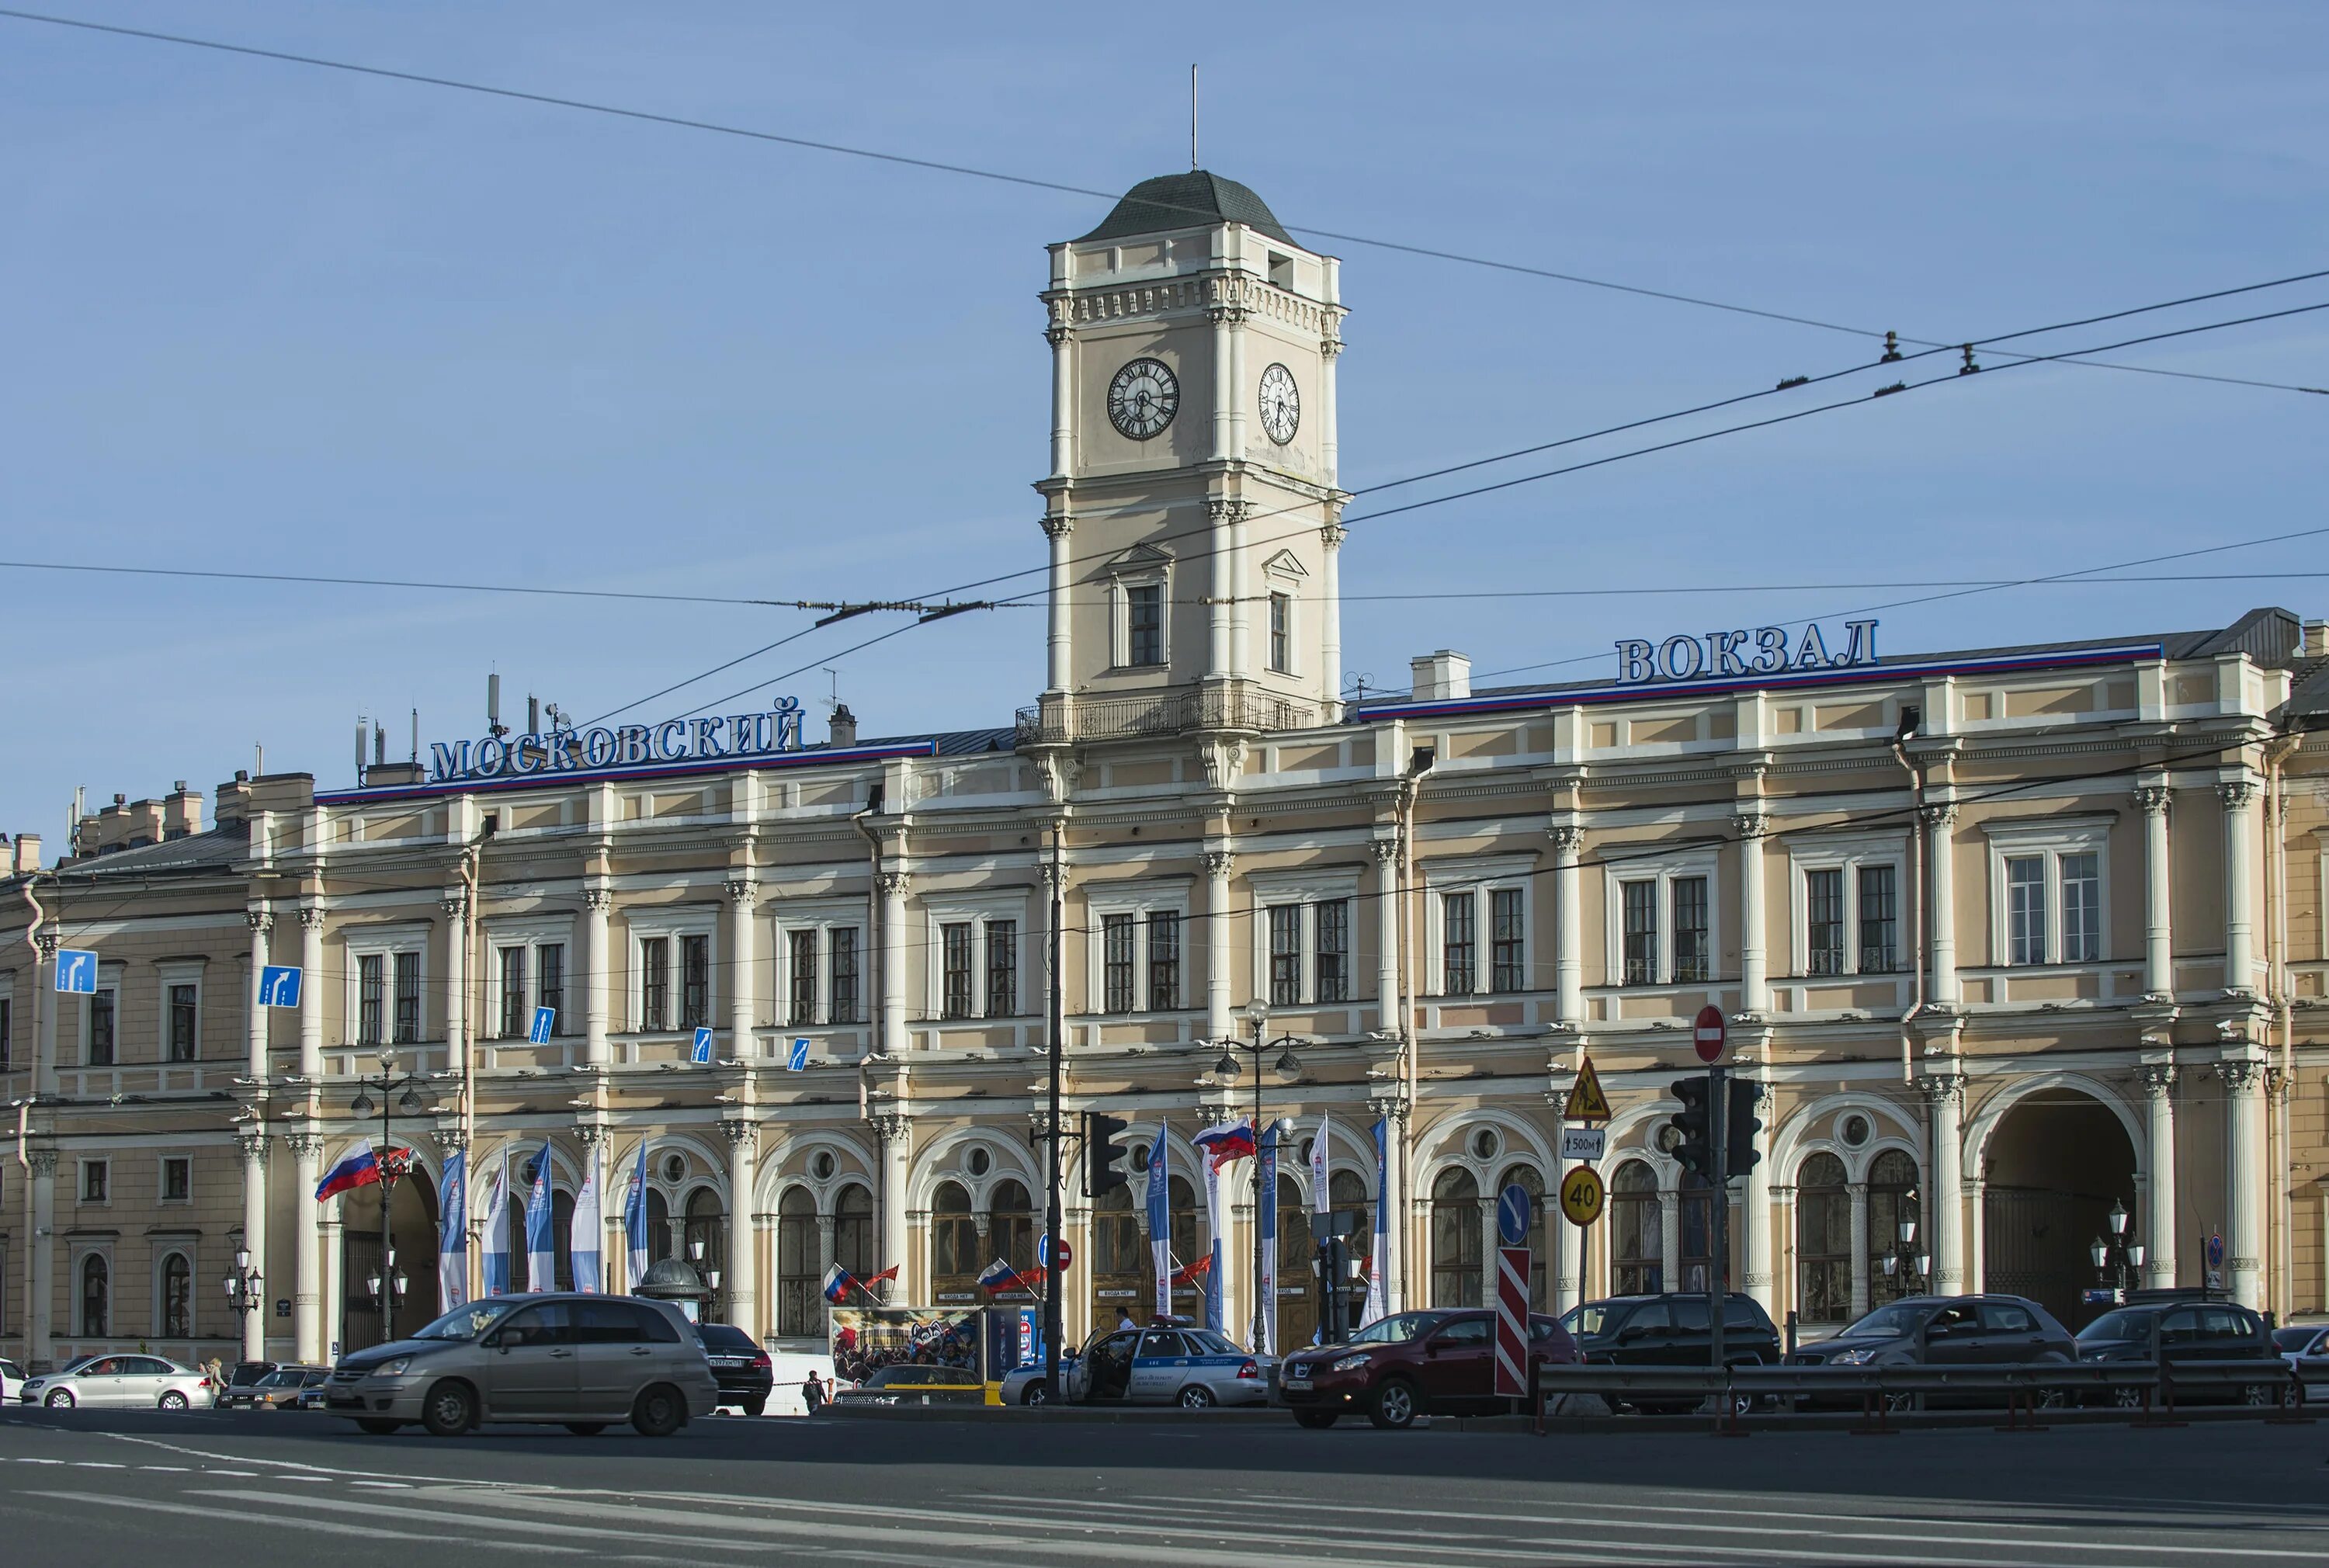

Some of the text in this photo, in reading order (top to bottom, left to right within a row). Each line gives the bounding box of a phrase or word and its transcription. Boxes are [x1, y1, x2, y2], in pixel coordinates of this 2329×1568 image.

[1614, 619, 1880, 685] ВОКЗАЛ
[429, 696, 806, 782] МОСКОВСКИЙ
[1572, 1138, 1595, 1150] 500м
[1570, 1183, 1595, 1207] 40
